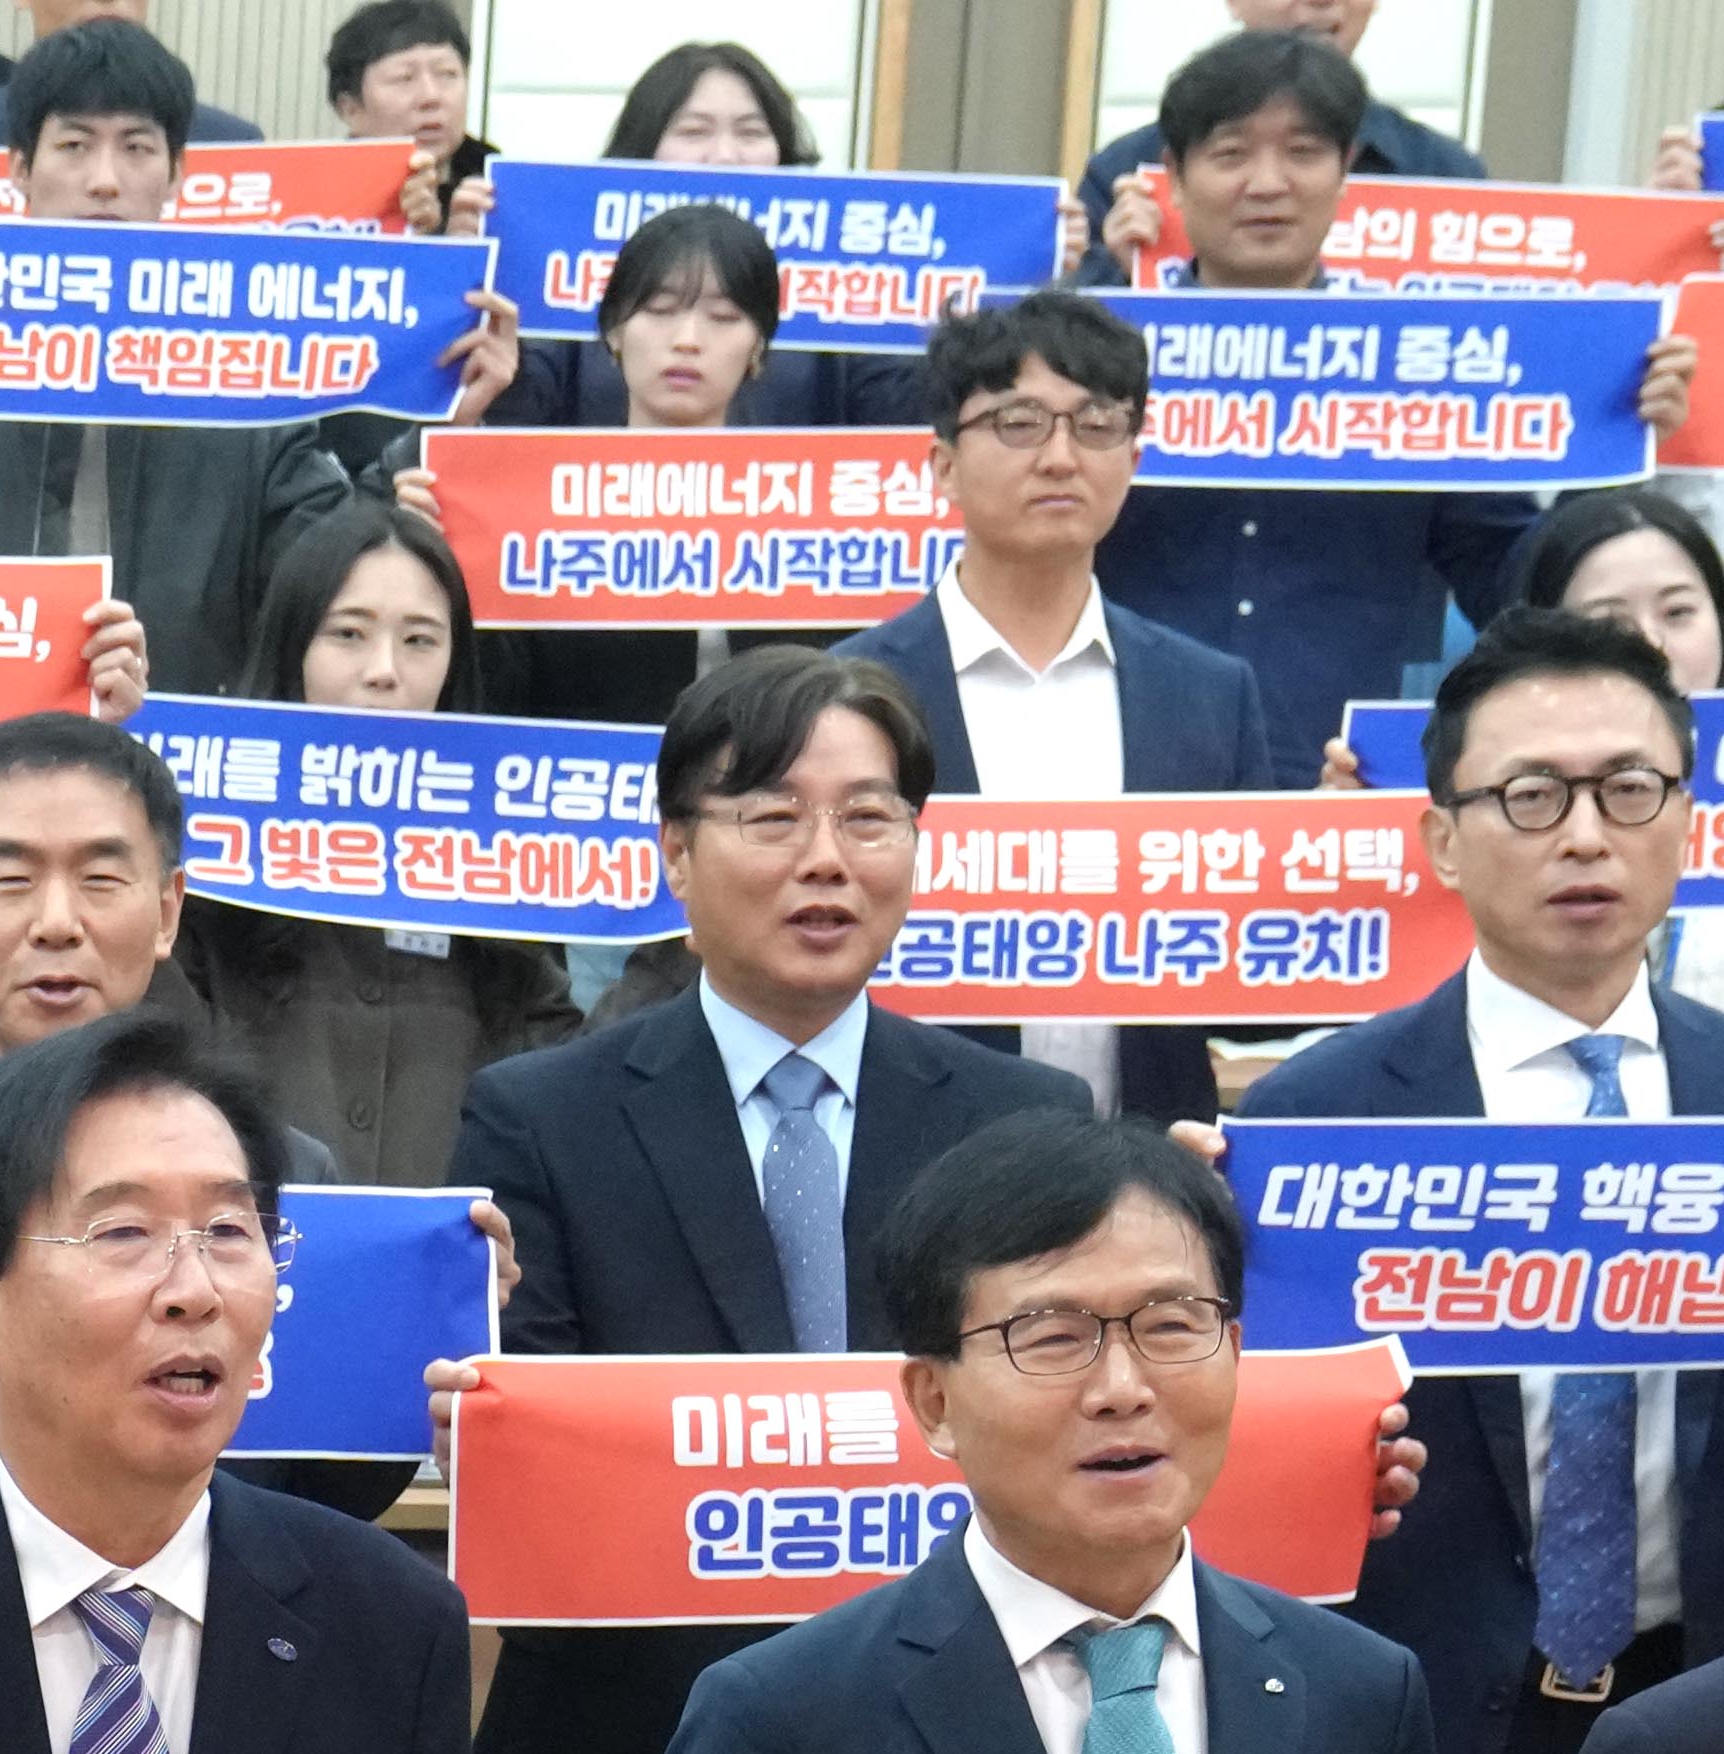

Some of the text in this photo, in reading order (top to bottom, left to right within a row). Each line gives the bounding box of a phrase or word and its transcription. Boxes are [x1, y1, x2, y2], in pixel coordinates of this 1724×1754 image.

[160, 172, 282, 219] 으로,
[840, 203, 946, 257] 중심,
[1431, 213, 1587, 271] 힘으로,
[130, 259, 230, 319] 미래
[248, 265, 419, 329] 에너지,
[110, 332, 377, 395] 책임집니다
[1148, 325, 1522, 388] 래에너지 중심,
[1288, 396, 1568, 459] 시작합니다
[550, 461, 949, 520] 미래에너지 중심,
[503, 538, 712, 592] 나주에서
[150, 734, 659, 822] 래를 밝히는 인공태
[188, 819, 653, 901] 그 빛은 전남에서!
[912, 829, 1420, 897] 세대를 위한 선택,
[875, 914, 1388, 981] 공태양 나주 유치!
[1257, 1161, 1724, 1234] 대한민국 핵융
[1361, 1253, 1583, 1325] 전남이
[671, 1389, 900, 1468] 미래를
